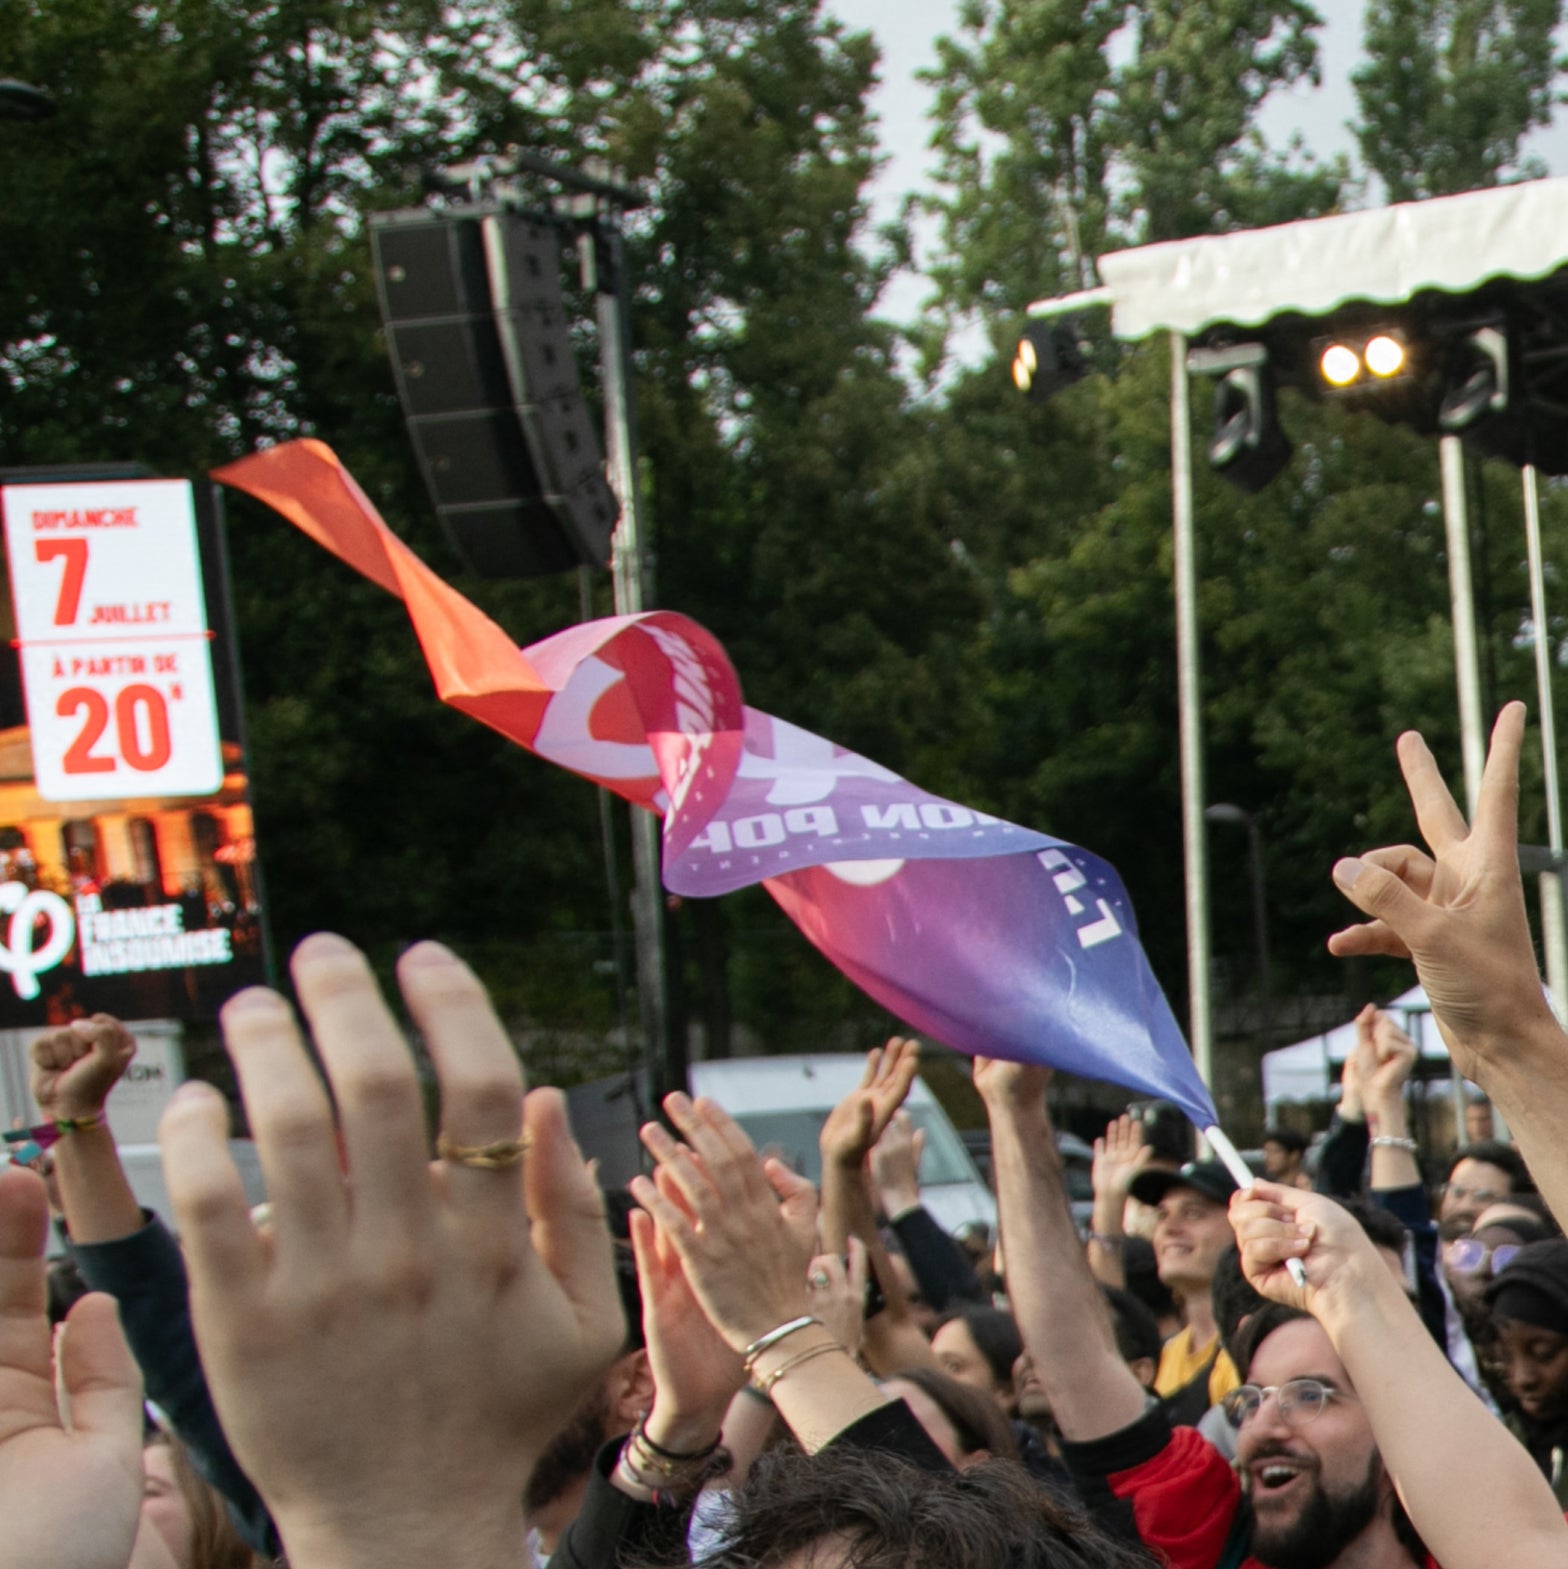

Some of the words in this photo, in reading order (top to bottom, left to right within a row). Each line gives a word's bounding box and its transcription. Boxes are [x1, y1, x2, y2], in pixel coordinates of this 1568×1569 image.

[32, 508, 137, 530] DIMANCHE
[34, 537, 88, 625] 7
[91, 603, 170, 624] JUILLET
